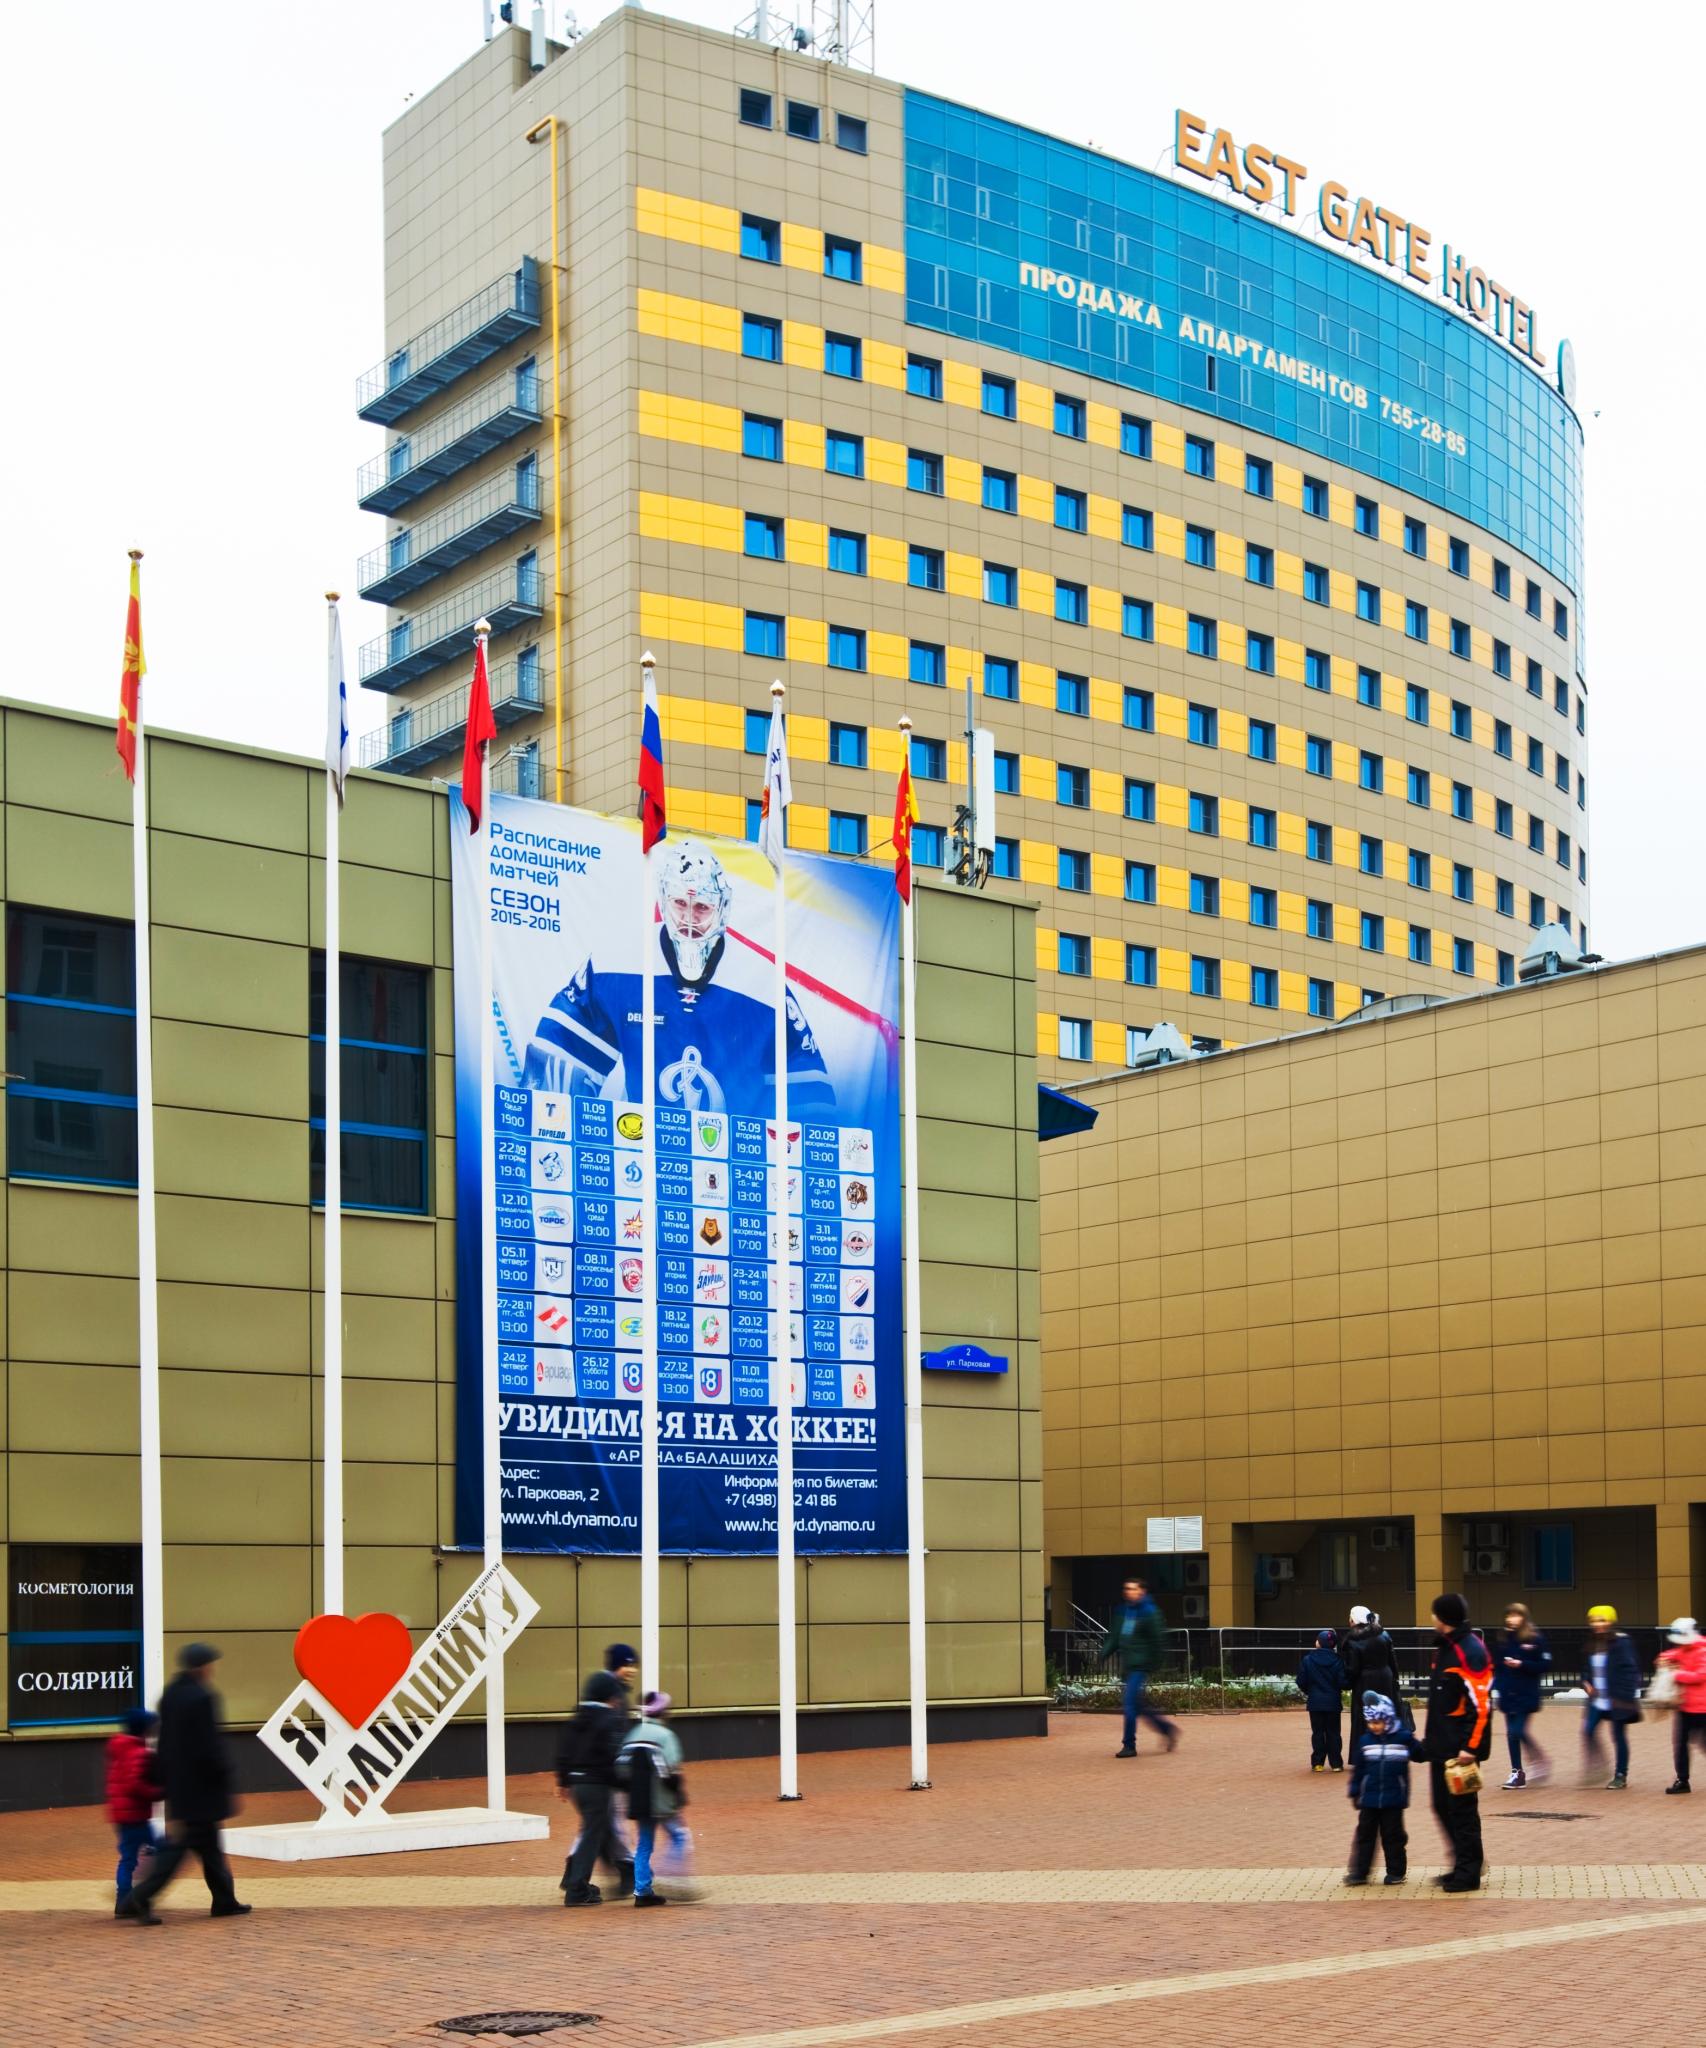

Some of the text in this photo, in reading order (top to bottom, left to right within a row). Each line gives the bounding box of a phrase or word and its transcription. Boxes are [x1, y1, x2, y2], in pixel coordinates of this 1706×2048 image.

[1175, 108, 1547, 368] EAST GATE HOTEL
[1020, 261, 1467, 457] ПРОДАЖА АПАРТАМЕНТОВ 755-28-85
[490, 822, 601, 860] Расписание
[490, 844, 587, 875] домашних
[490, 862, 558, 887] матчей
[490, 887, 561, 916] СЕЗОН
[490, 908, 561, 933] 2015-2016
[582, 1102, 606, 1115] 11.09
[660, 1111, 686, 1124] 13.09
[581, 1125, 608, 1138] 19:00
[736, 1120, 761, 1133] 15.09
[538, 1128, 566, 1139] ТОРПЕДО
[808, 1130, 835, 1141] 20.09
[661, 1134, 686, 1147] 17:00
[736, 1142, 761, 1155] 19:00
[580, 1151, 610, 1165] 25.09
[810, 1150, 834, 1162] 13:00
[660, 1162, 688, 1173] 27.09
[581, 1174, 609, 1187] 19:00
[734, 1169, 764, 1181] 3-4.10
[808, 1177, 836, 1188] 7-8.10
[661, 1183, 687, 1196] 13:00
[502, 1194, 528, 1206] 12.10
[736, 1191, 761, 1202] 13:00
[584, 1202, 608, 1214] 14.10
[811, 1199, 835, 1210] 19:00
[538, 1215, 565, 1225] ТОРОС
[664, 1210, 686, 1221] 16.10
[500, 1217, 530, 1229] 19:00
[739, 1218, 760, 1229] 18.10
[583, 1224, 610, 1237] 19:00
[815, 1224, 830, 1235] 3.11
[663, 1232, 688, 1244] 19:00
[738, 1239, 762, 1251] 17:00
[811, 1245, 837, 1256] 19:00
[502, 1246, 526, 1258] 05.11
[584, 1254, 607, 1265] 08.11
[667, 1261, 686, 1272] 10.11
[499, 1269, 528, 1282] 19:00
[732, 1268, 767, 1280] 23-24.11
[814, 1272, 835, 1282] 27.11
[582, 1276, 608, 1288] 17:00
[663, 1283, 688, 1295] 19:00
[738, 1290, 763, 1301] 19:00
[812, 1294, 835, 1304] 19:00
[583, 1305, 607, 1316] 29.11
[664, 1310, 687, 1322] 18.12
[738, 1315, 763, 1327] 20.12
[500, 1322, 528, 1333] 13:00
[582, 1328, 609, 1339] 17:00
[662, 1332, 688, 1344] 19:00
[738, 1337, 763, 1348] 17:00
[813, 1342, 835, 1352] 19:00
[966, 1347, 971, 1356] 2
[503, 1353, 527, 1363] 24.12
[582, 1357, 609, 1368] 26.12
[958, 1358, 991, 1369] Парковая
[663, 1361, 688, 1372] 27.12
[742, 1365, 760, 1376] 11.01
[814, 1368, 834, 1379] 12.01
[501, 1375, 528, 1386] 19:00
[582, 1380, 609, 1391] 13:00
[663, 1383, 688, 1394] 13:00
[738, 1387, 764, 1398] 19:00
[812, 1391, 835, 1401] 19:00
[693, 1412, 738, 1441] НА
[724, 1474, 878, 1490] Информия по билетам:
[517, 1485, 587, 1503] Парковая,
[589, 1488, 600, 1501] 2
[724, 1493, 740, 1506] +7
[741, 1493, 777, 1509] (498)
[804, 1494, 818, 1506] 41
[820, 1494, 837, 1507] 86
[498, 1510, 638, 1529] www.vhl.dynamo.ru
[18, 1582, 134, 1595] КОСМЕТОЛОГИЯ
[17, 1665, 134, 1692] СОЛЯРИЙ
[322, 1572, 520, 1818] БАЛАШИХУ
[280, 1698, 327, 1767] Я
